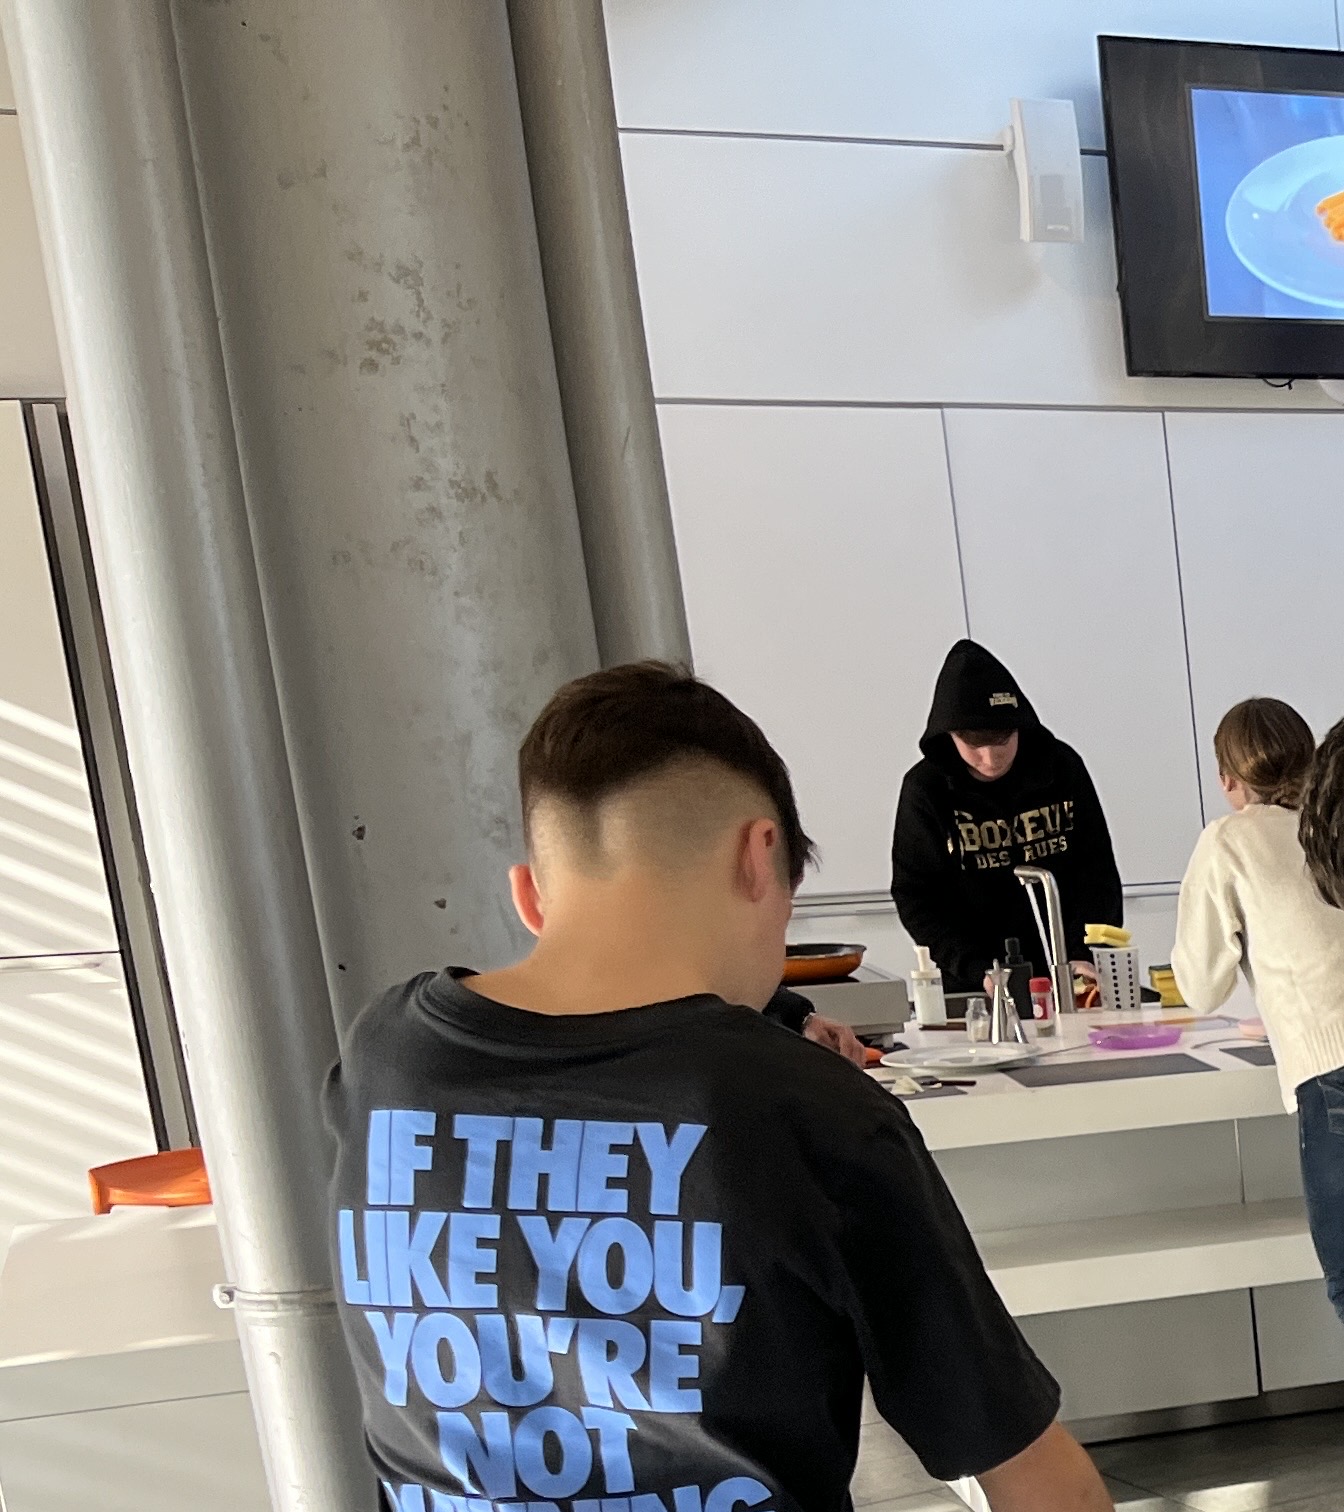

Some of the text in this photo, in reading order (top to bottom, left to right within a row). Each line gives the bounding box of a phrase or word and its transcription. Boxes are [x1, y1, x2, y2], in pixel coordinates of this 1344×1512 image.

[975, 850, 1012, 870] DES
[367, 1109, 708, 1216] IF THEY
[338, 1209, 746, 1324] LIKE YOU,
[365, 1310, 703, 1413] YOU'RE
[437, 1406, 639, 1499] NOT
